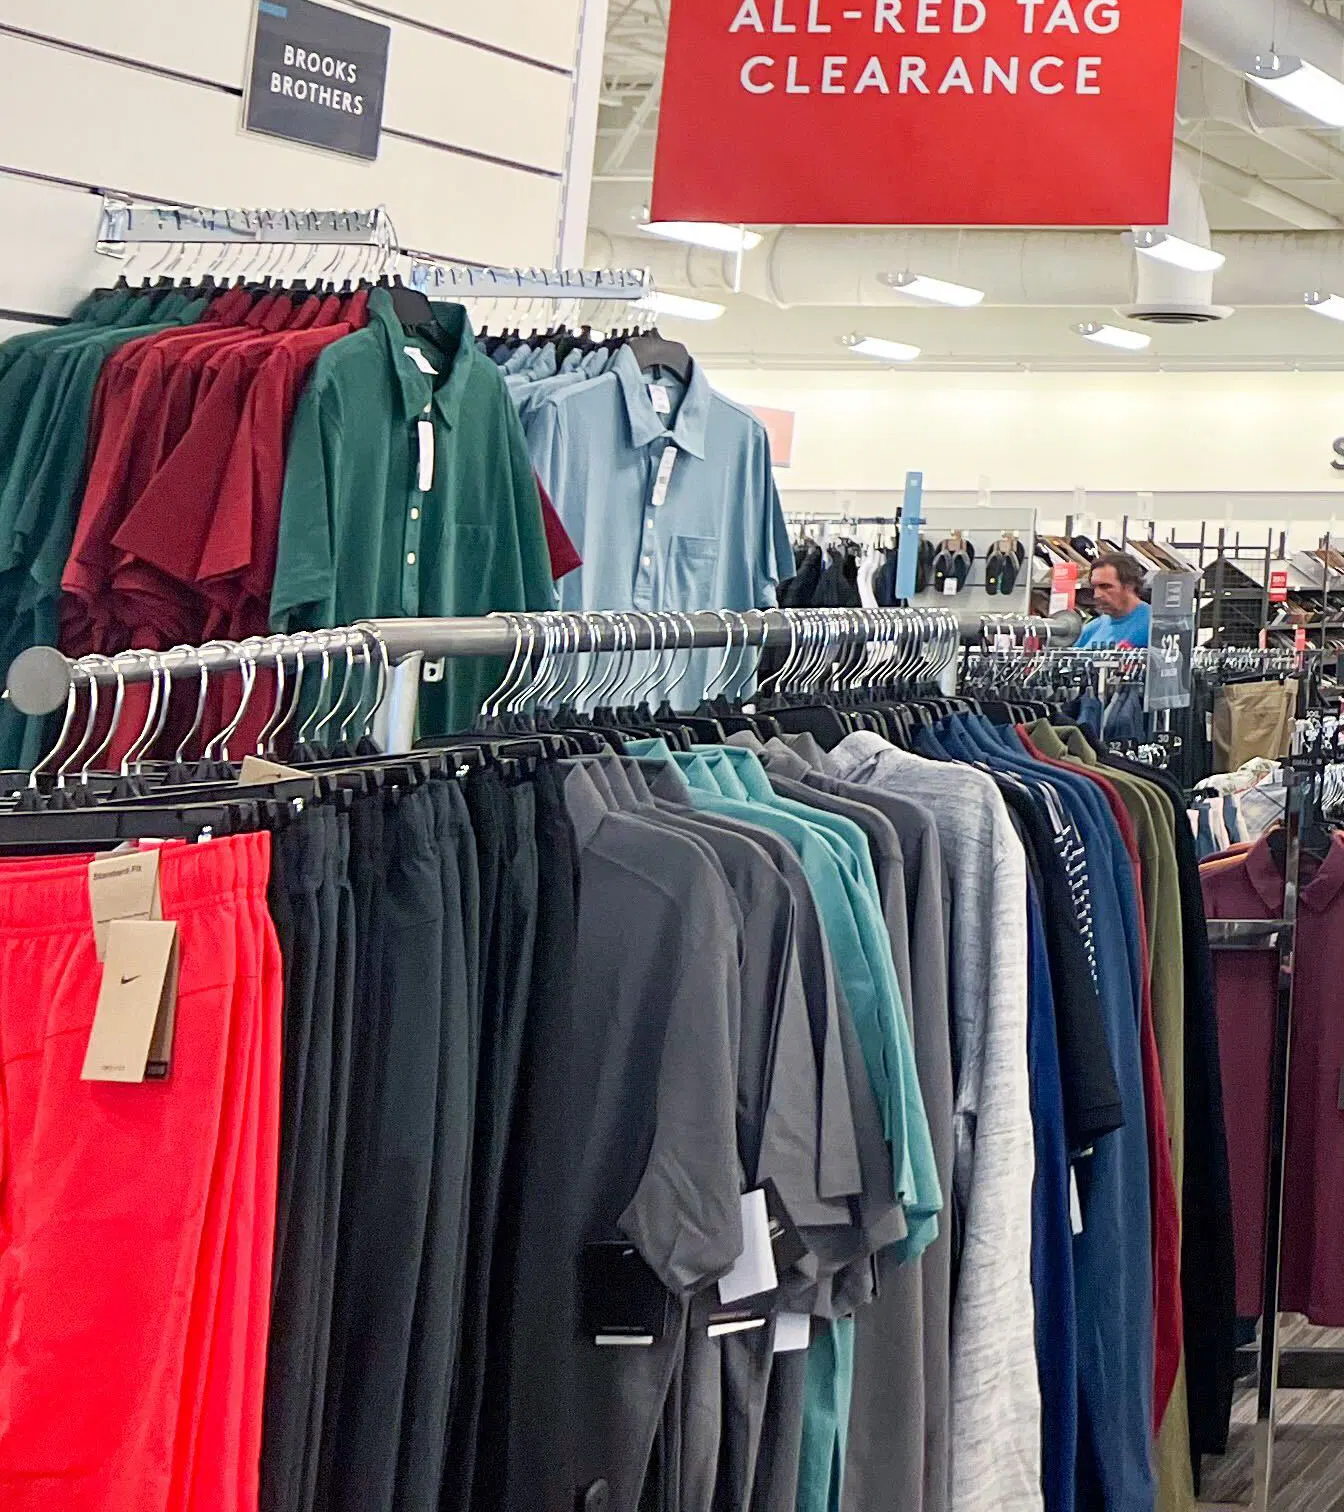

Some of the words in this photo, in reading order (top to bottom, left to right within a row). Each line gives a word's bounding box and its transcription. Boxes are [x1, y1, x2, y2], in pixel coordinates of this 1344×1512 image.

[284, 44, 358, 84] BROOKS
[741, 55, 1102, 95] CLEARANCE
[270, 72, 364, 115] BROTHERS
